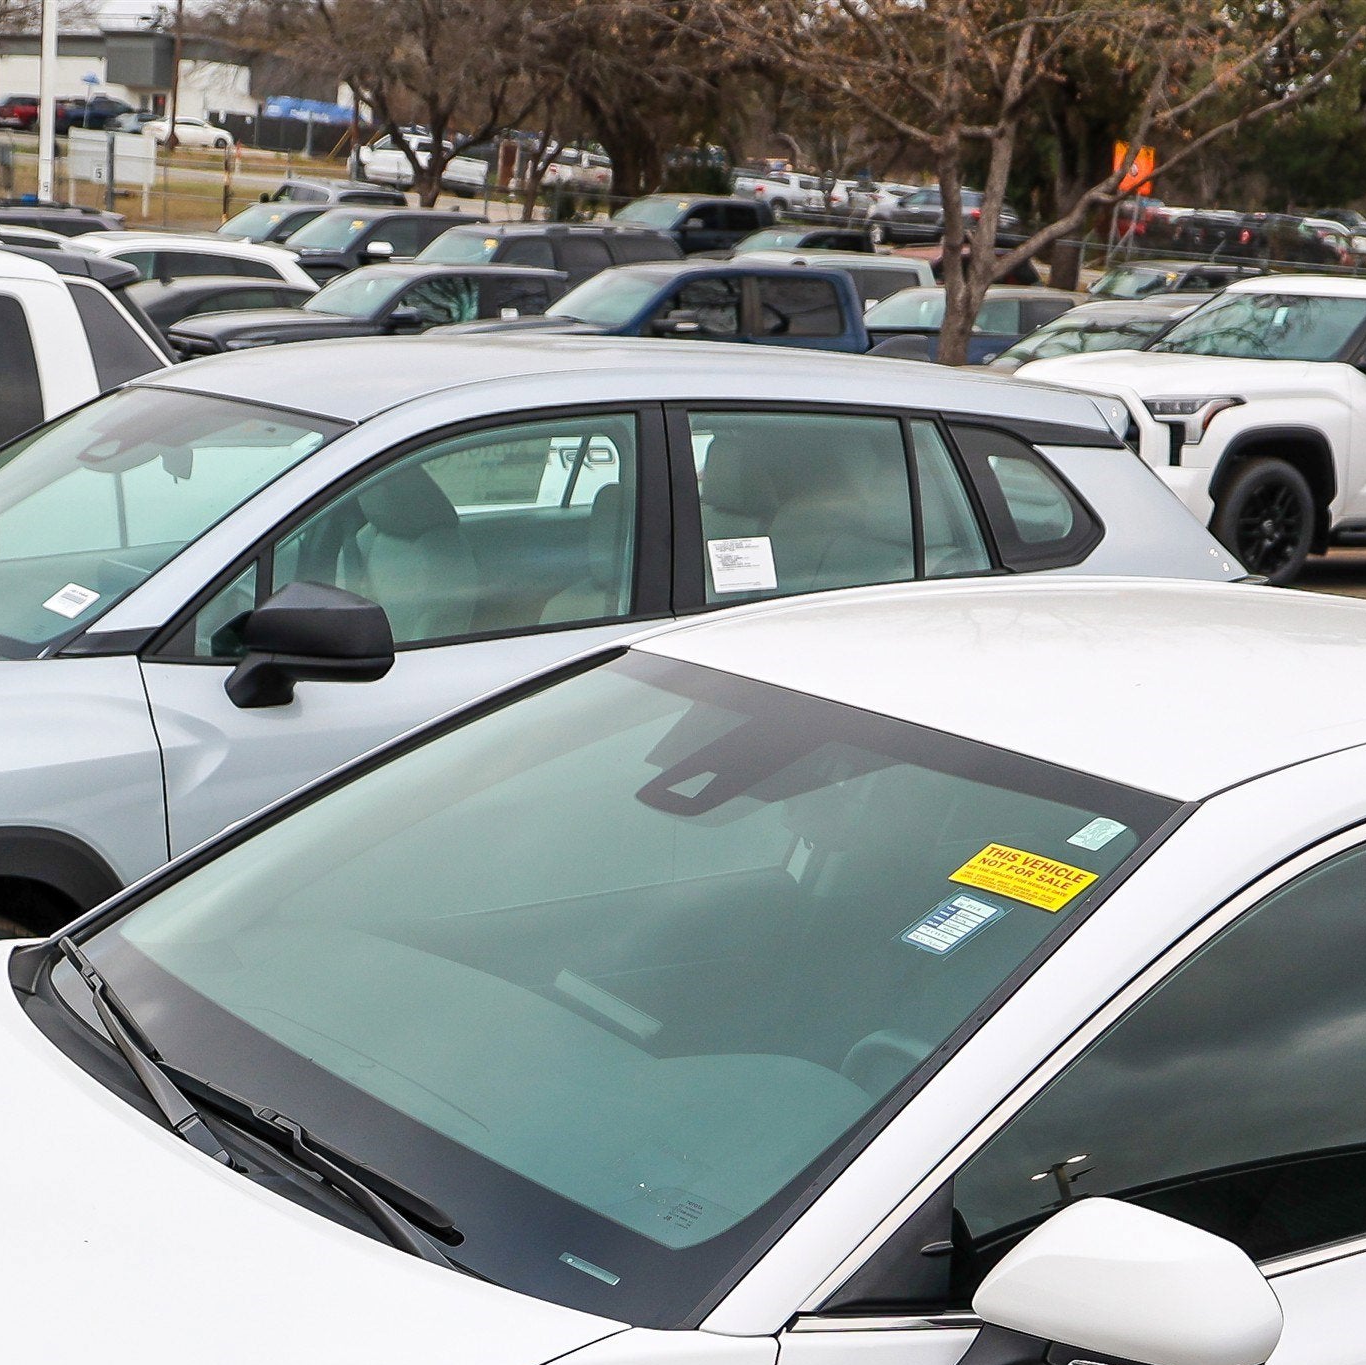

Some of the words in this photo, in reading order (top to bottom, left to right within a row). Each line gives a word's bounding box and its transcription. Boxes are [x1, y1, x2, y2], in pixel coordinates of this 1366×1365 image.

[978, 856, 1007, 869] NOT
[1005, 864, 1036, 877] FOR
[1034, 874, 1073, 889] SALE
[985, 847, 1022, 862] THIS
[1021, 856, 1088, 883] VEHICLE
